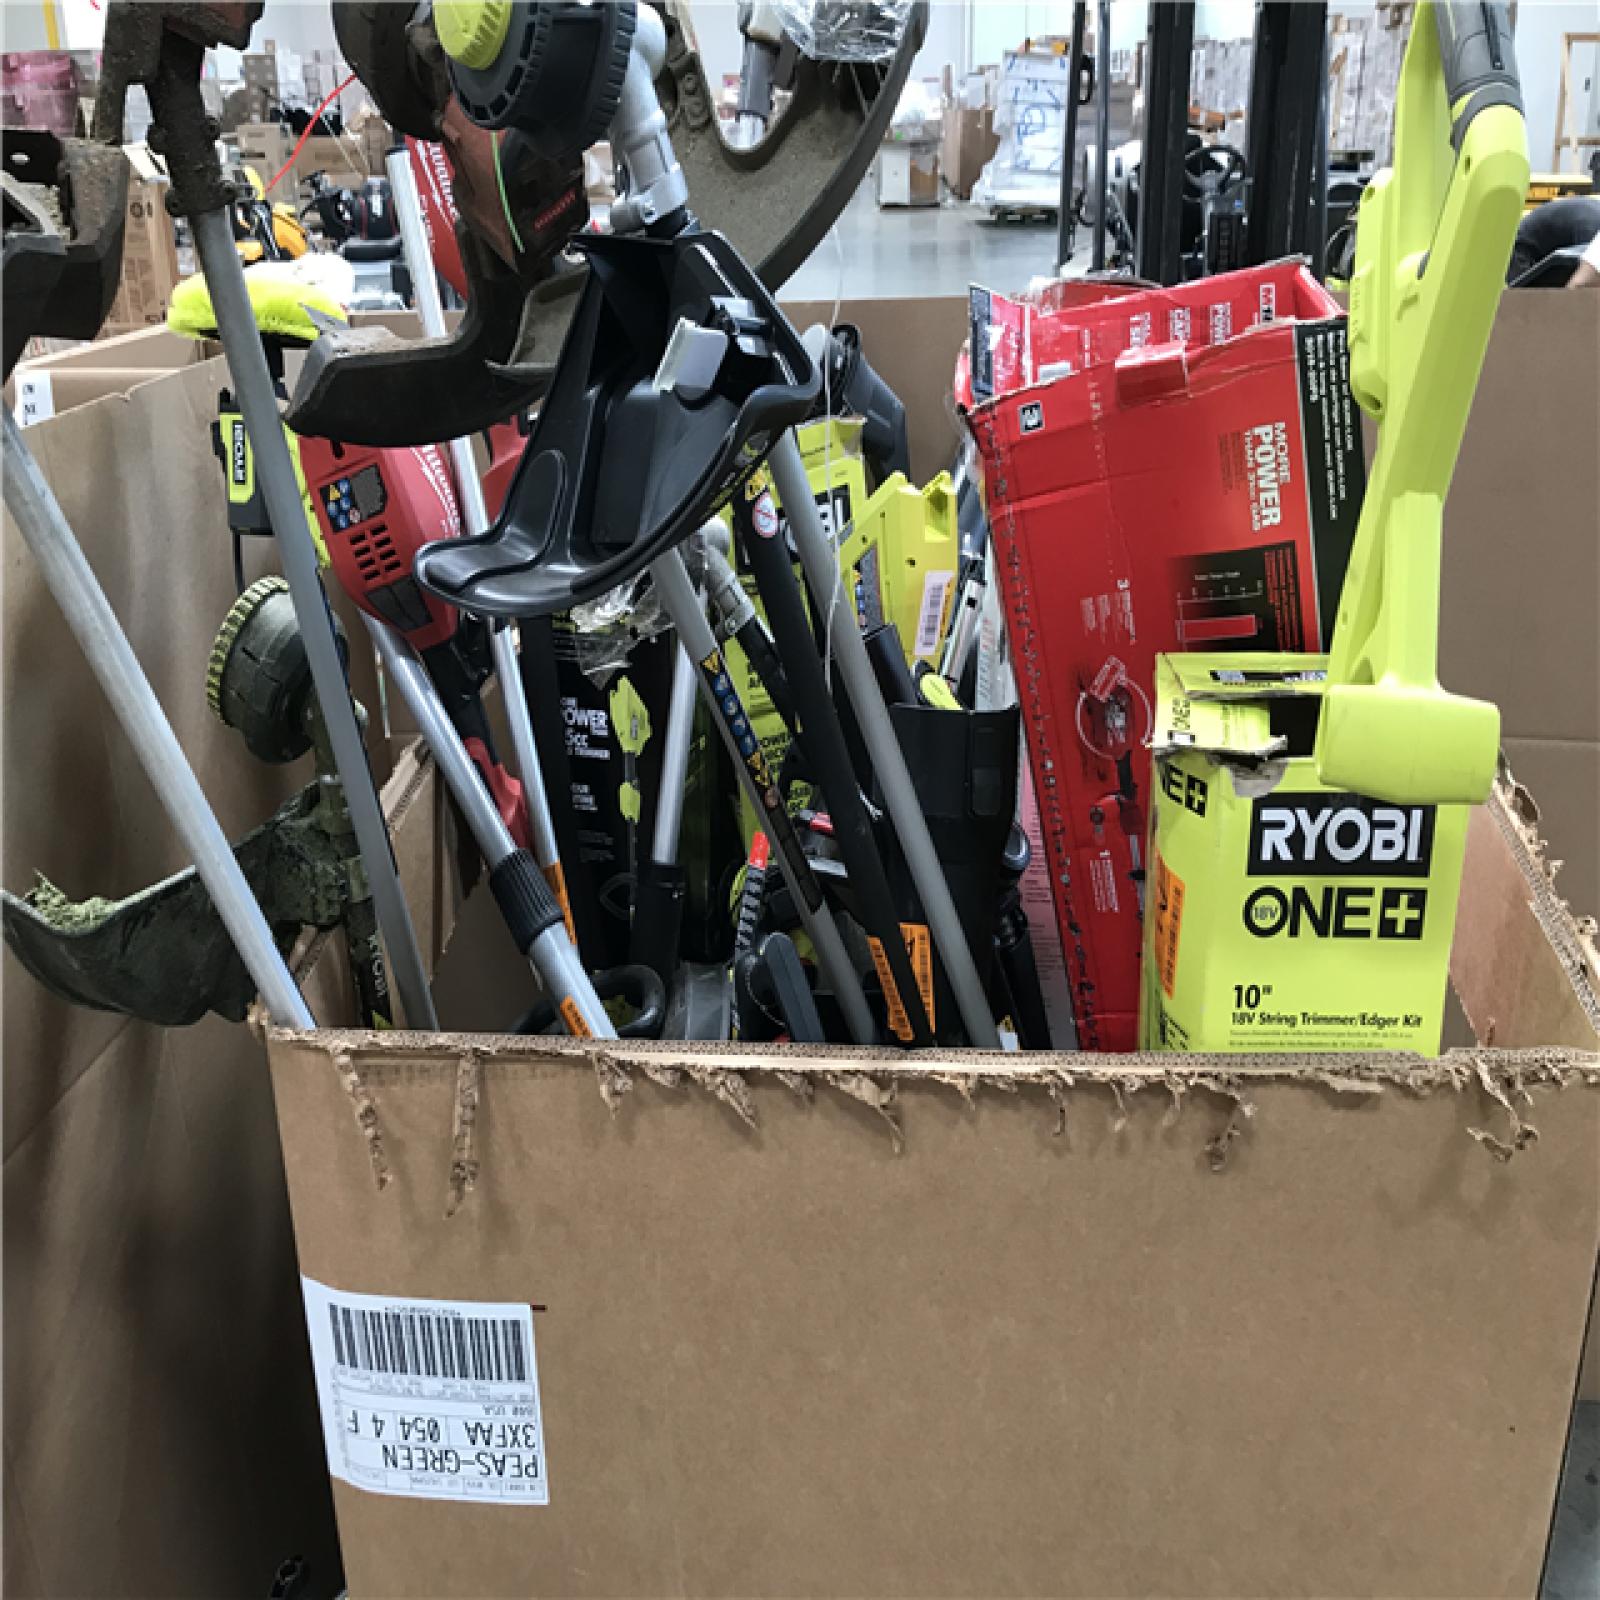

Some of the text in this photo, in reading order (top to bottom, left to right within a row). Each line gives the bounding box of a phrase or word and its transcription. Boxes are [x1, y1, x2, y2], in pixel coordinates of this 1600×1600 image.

[1254, 424, 1281, 526] POWER
[1260, 807, 1423, 863] RYOBI
[1234, 984, 1273, 1009] 10"
[1232, 1012, 1255, 1026] 18V
[1259, 1012, 1297, 1028] String
[1402, 1013, 1423, 1029] Kit
[371, 1412, 386, 1439] 4
[399, 1416, 441, 1442] 054
[464, 1421, 536, 1450] 3XFAA
[382, 1444, 538, 1478] PEAS-GREEN
